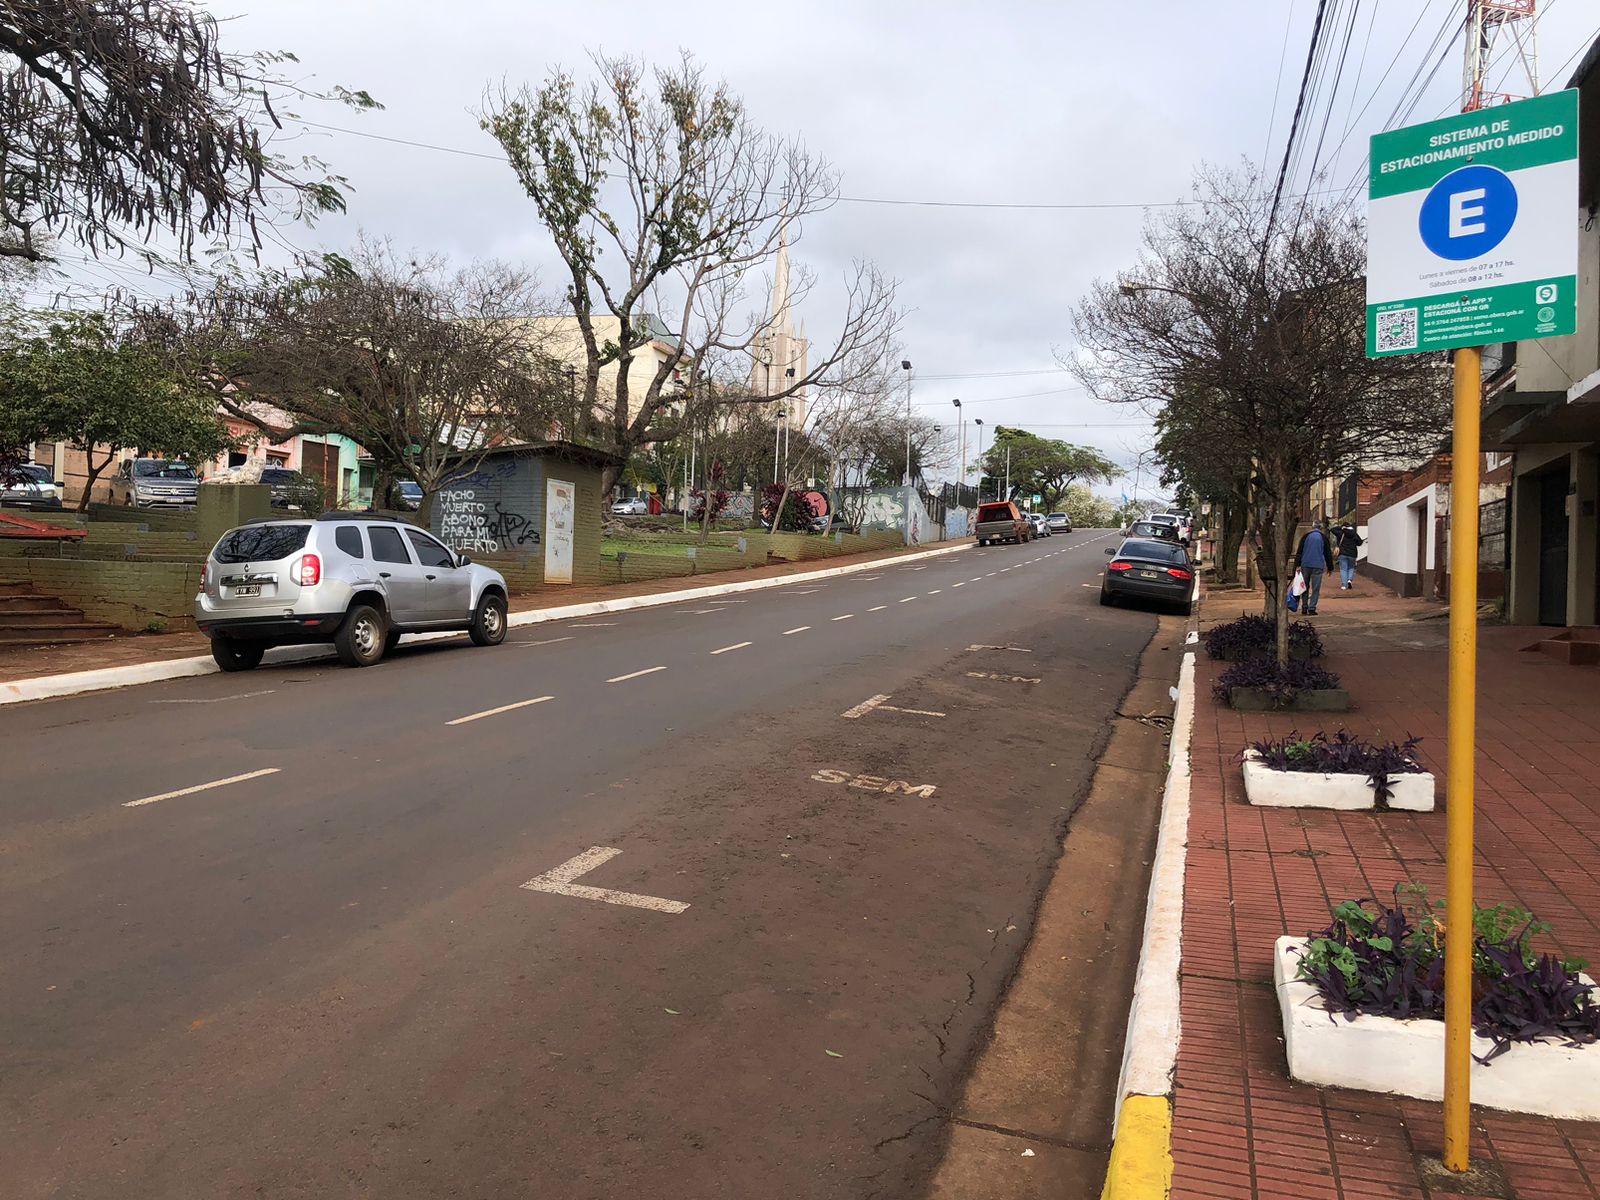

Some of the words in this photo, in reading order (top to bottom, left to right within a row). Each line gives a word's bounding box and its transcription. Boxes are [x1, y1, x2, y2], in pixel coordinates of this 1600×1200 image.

[1429, 124, 1488, 147] SISTEMA
[1491, 119, 1510, 134] DE
[1380, 137, 1504, 174] ESTACIONAMIENTO
[1507, 124, 1564, 146] MEDIDO
[1449, 188, 1486, 238] E
[1419, 271, 1438, 280] Lunes
[1444, 267, 1468, 276] viernes
[1478, 263, 1488, 271] 07
[1458, 276, 1467, 284] de
[1471, 297, 1487, 305] APP
[1462, 305, 1478, 313] CON
[440, 490, 475, 502] FACHO
[440, 502, 486, 513] MUERTO
[441, 513, 485, 526] ABONO
[441, 526, 474, 538] PARA
[476, 526, 490, 540] MI
[446, 538, 498, 553] HUERTO
